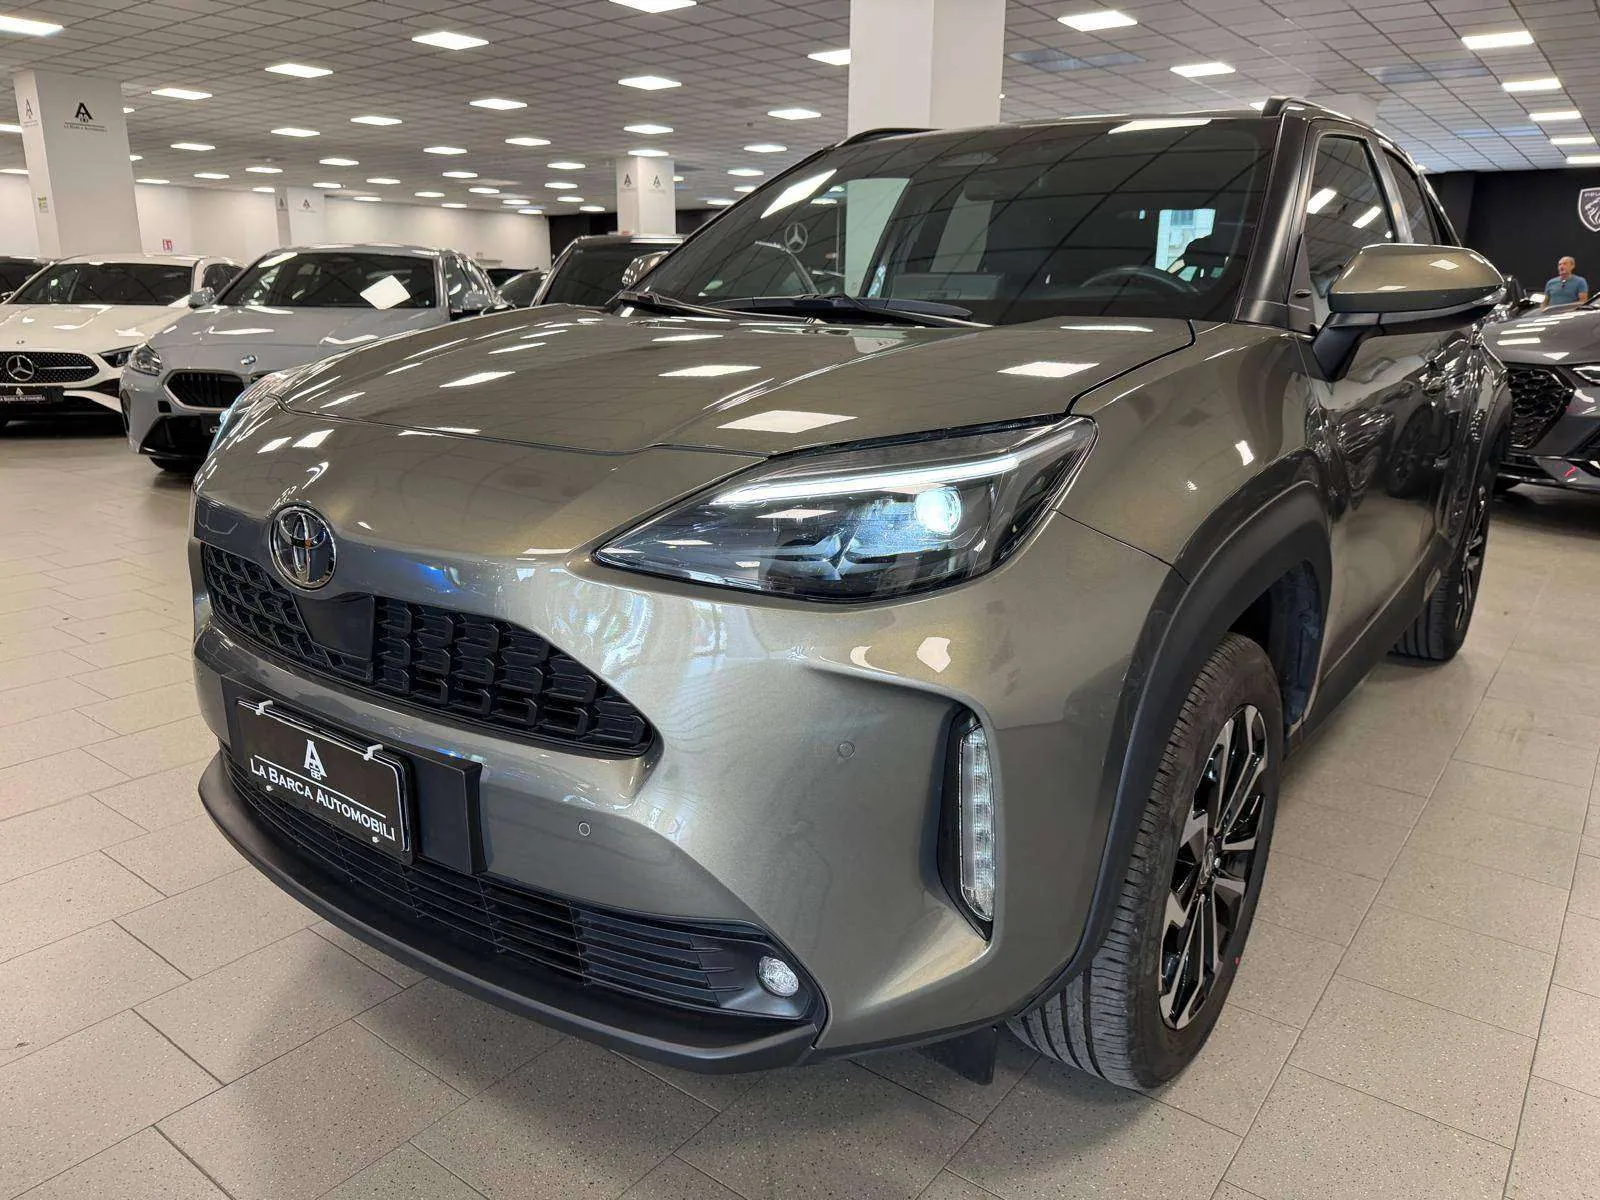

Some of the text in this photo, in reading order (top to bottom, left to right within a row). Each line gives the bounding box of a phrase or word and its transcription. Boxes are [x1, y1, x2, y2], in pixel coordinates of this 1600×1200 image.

[250, 758, 395, 842] LA BARCA AUTOMOBILI
